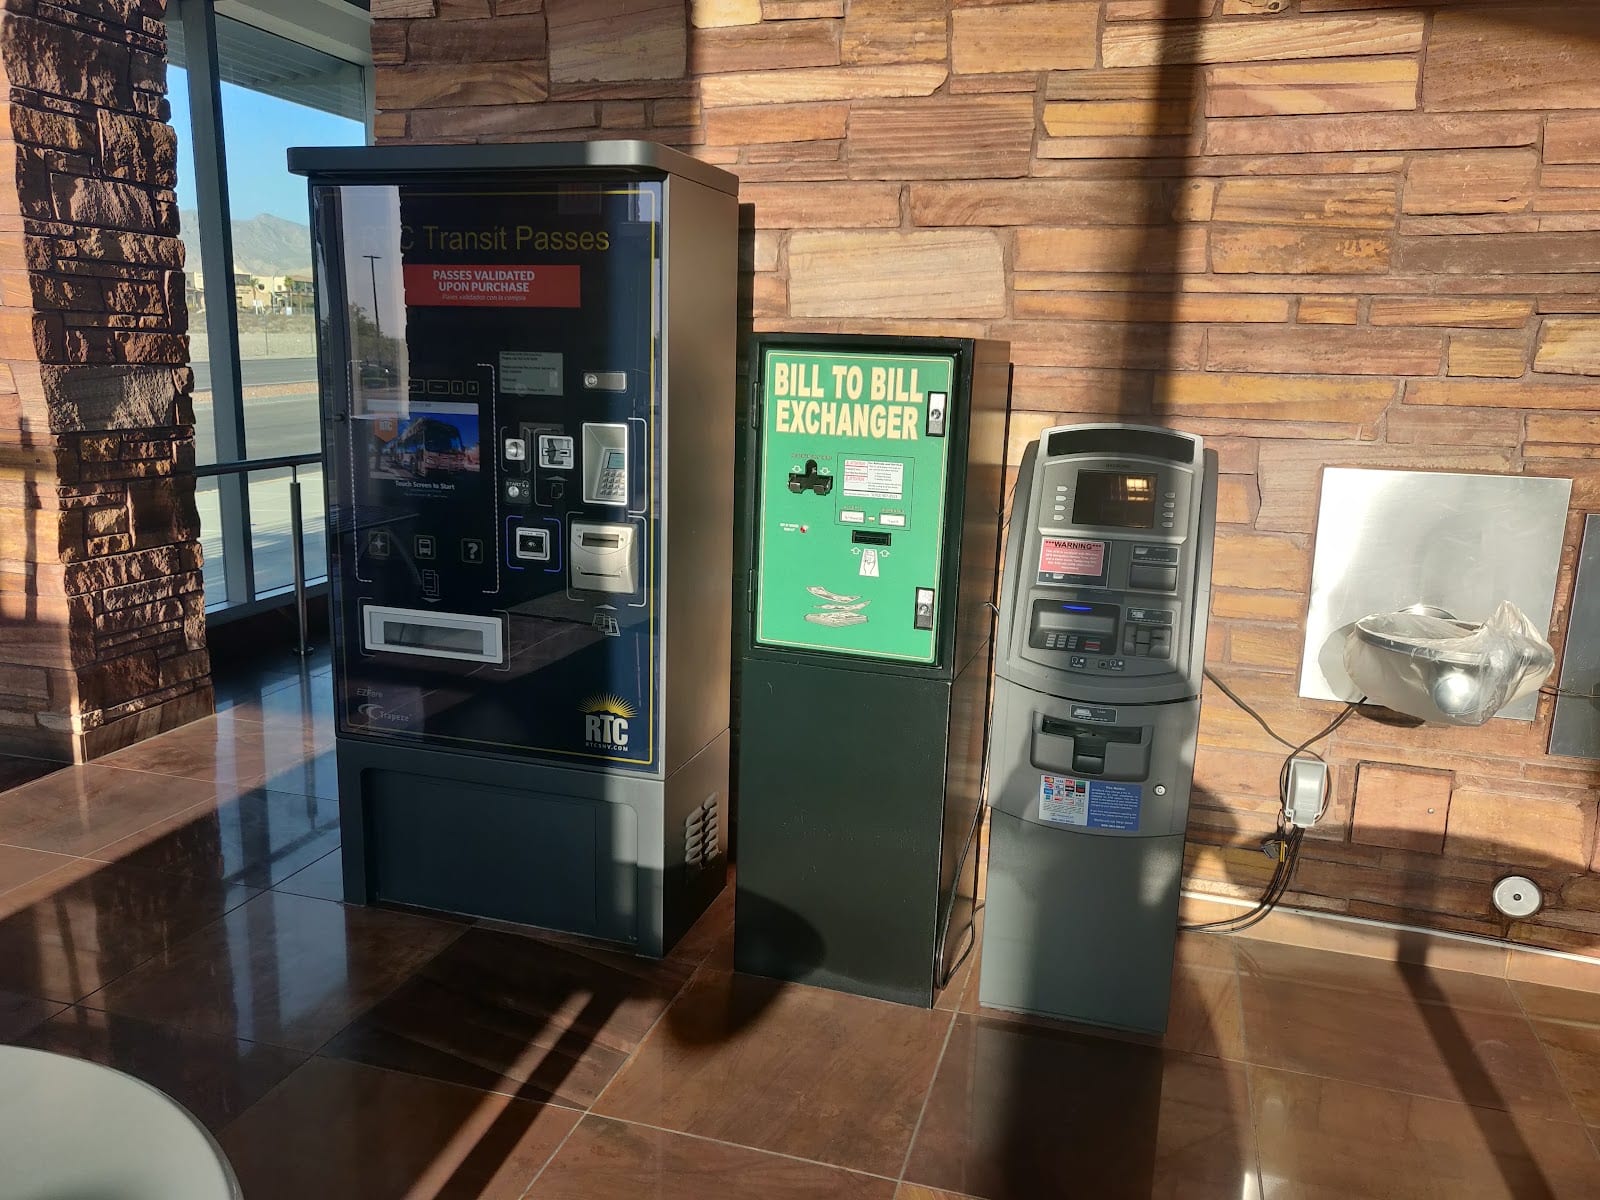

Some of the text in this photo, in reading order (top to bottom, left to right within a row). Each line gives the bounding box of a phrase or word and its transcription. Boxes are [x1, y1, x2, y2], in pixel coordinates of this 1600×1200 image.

[423, 225, 507, 250] Transit
[516, 225, 610, 250] Passes
[432, 270, 535, 281] PASSES VALIDATED
[438, 282, 530, 292] UPON PURCHASE
[774, 362, 923, 403] BILL TO BILL
[776, 399, 918, 440] EXCHANGER
[585, 714, 629, 746] RTC
